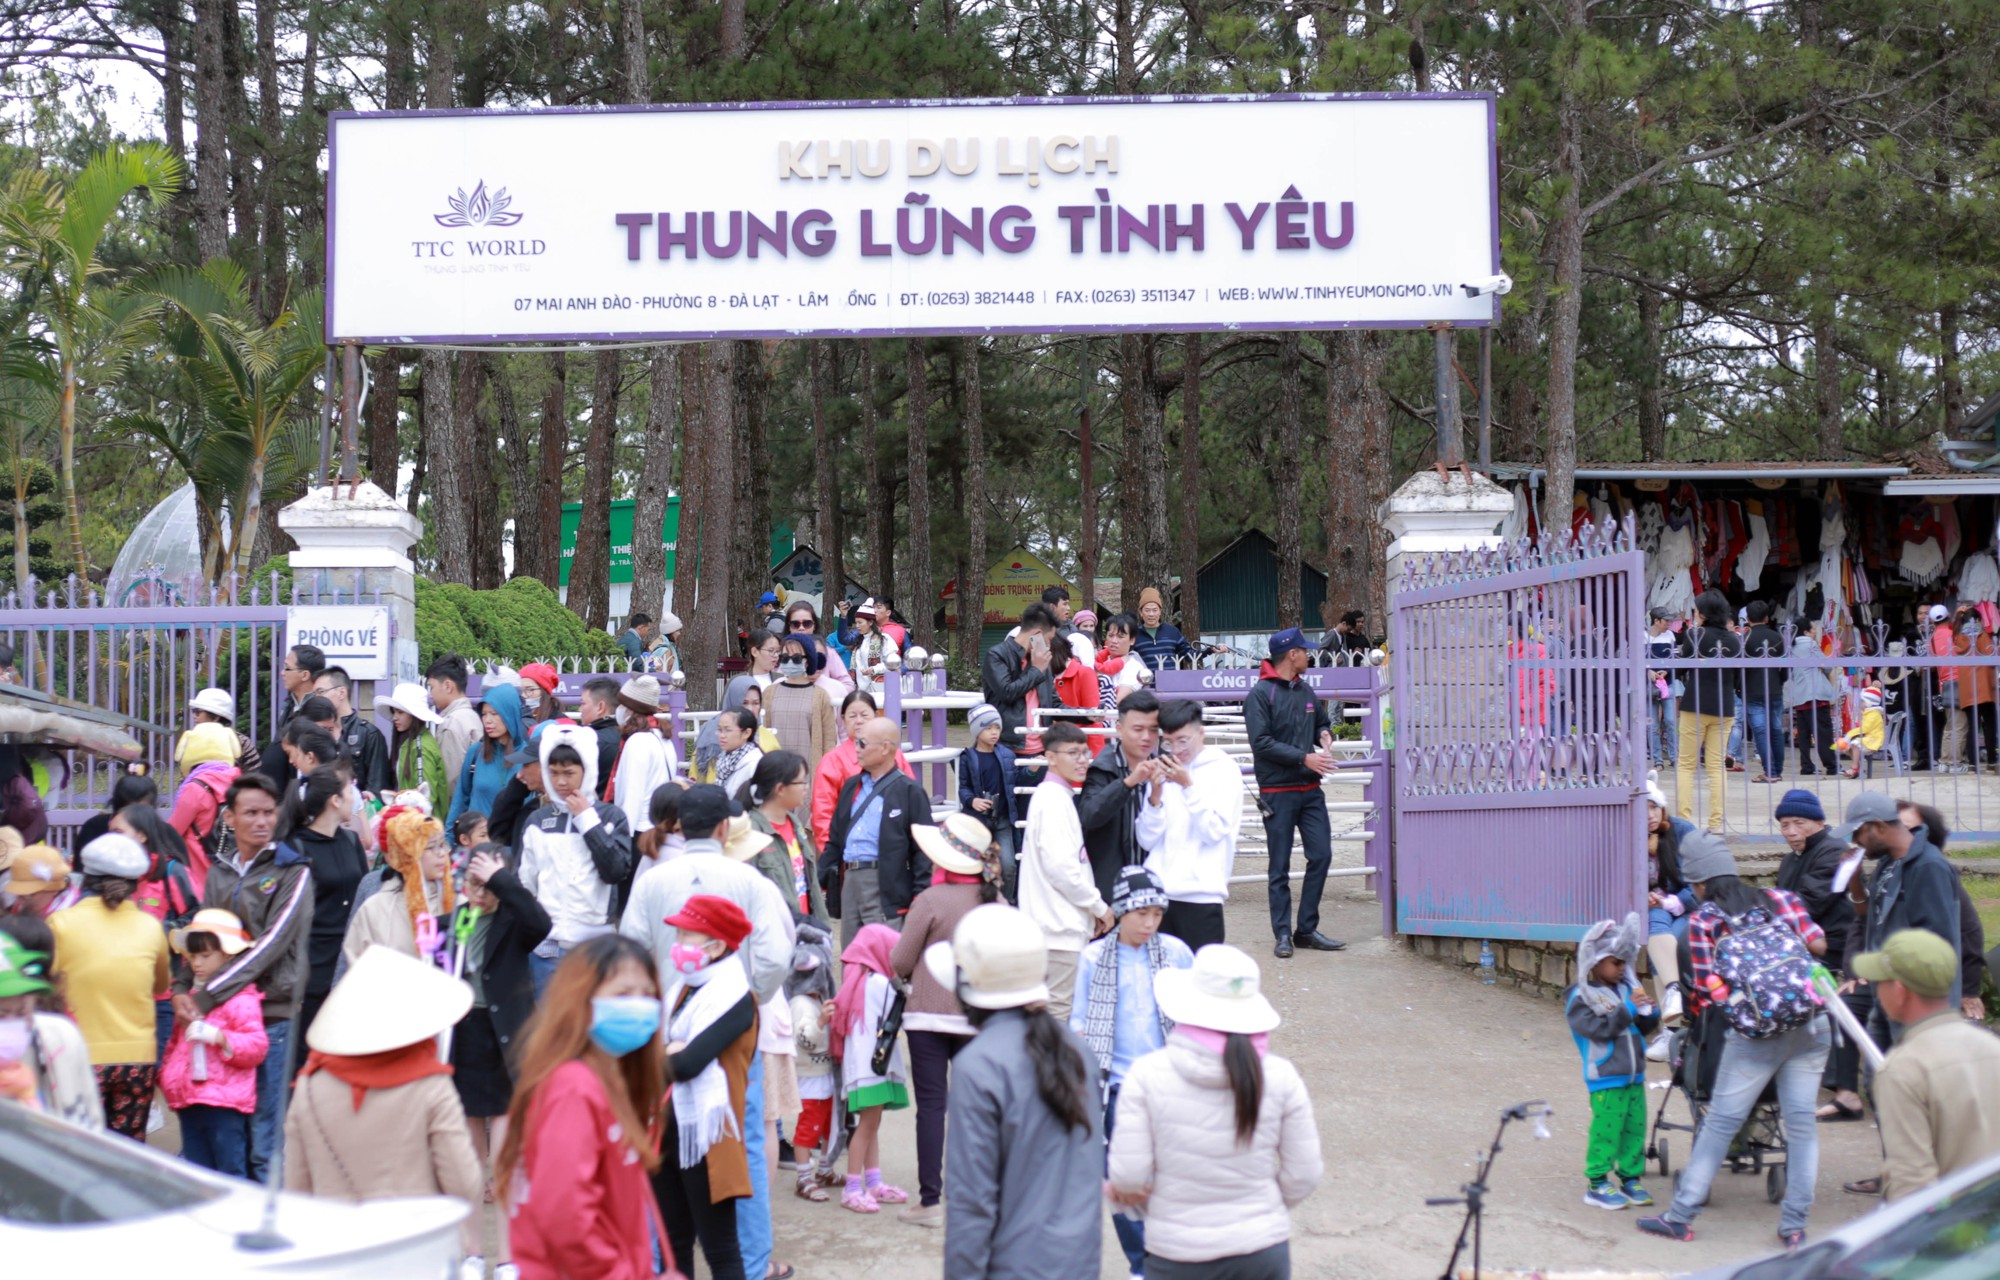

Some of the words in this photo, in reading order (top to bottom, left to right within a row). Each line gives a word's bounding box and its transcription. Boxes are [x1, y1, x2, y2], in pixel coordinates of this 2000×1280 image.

[779, 140, 891, 180] KHU
[907, 137, 980, 177] DU
[998, 134, 1119, 188] LỊCH
[615, 209, 837, 262] THUNG
[859, 191, 1038, 258] LŨNG
[1057, 187, 1206, 255] TÌNH
[1223, 183, 1355, 252] YÊU
[411, 240, 454, 258] TTC
[467, 239, 546, 257] WORLD
[513, 297, 532, 312] 07
[536, 297, 563, 311] MAI
[566, 297, 597, 311] ANH
[602, 293, 632, 310] ĐÀO
[642, 292, 703, 310] PHƯỜNG
[707, 295, 717, 309] 8
[729, 292, 749, 308] ĐÀ
[752, 294, 780, 311] LẠT
[798, 291, 829, 307] LÂM
[974, 291, 1035, 306] 3821448
[1141, 288, 1196, 303] 3511347
[298, 626, 354, 646] PHÒNG
[358, 626, 378, 646] VÉ
